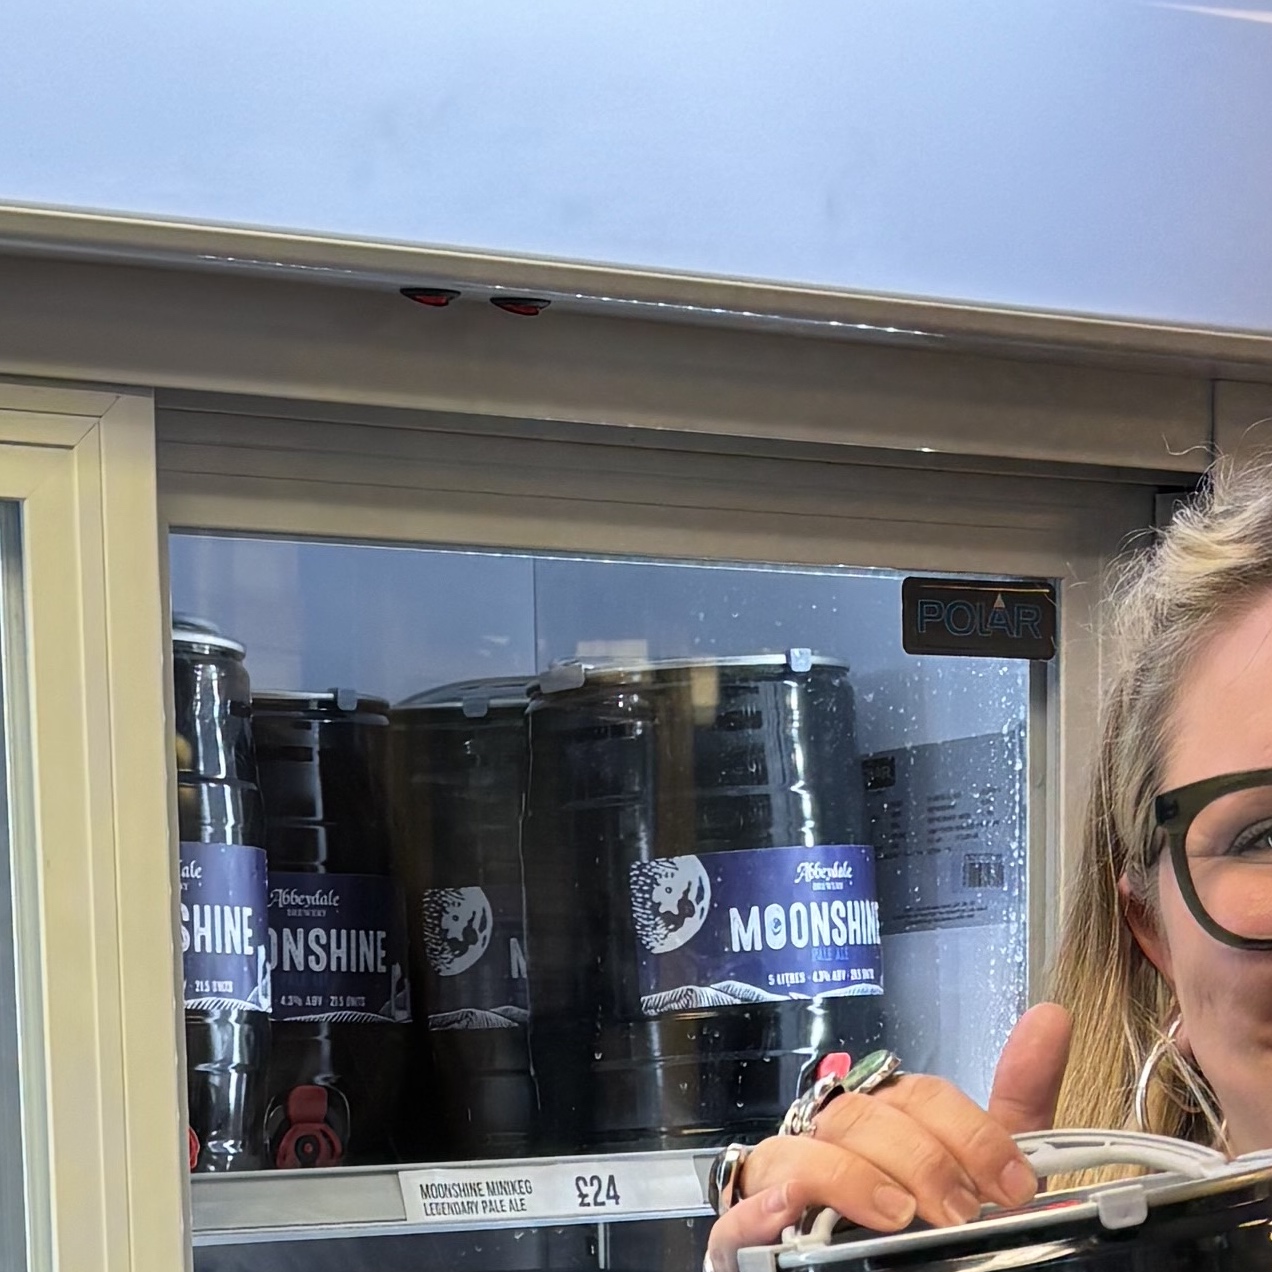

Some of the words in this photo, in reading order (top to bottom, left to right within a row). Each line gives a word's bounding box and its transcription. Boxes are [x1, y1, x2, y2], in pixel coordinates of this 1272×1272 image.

[917, 594, 1043, 639] POLAR
[267, 889, 340, 908] Abbeydale
[768, 973, 775, 986] 5
[419, 1182, 483, 1200] MOONSHINE
[485, 1179, 533, 1197] MINIKEG
[575, 1174, 621, 1208] £24
[423, 1201, 479, 1216] LEGENDARY
[482, 1200, 507, 1214] PALE
[509, 1198, 527, 1212] ALE
